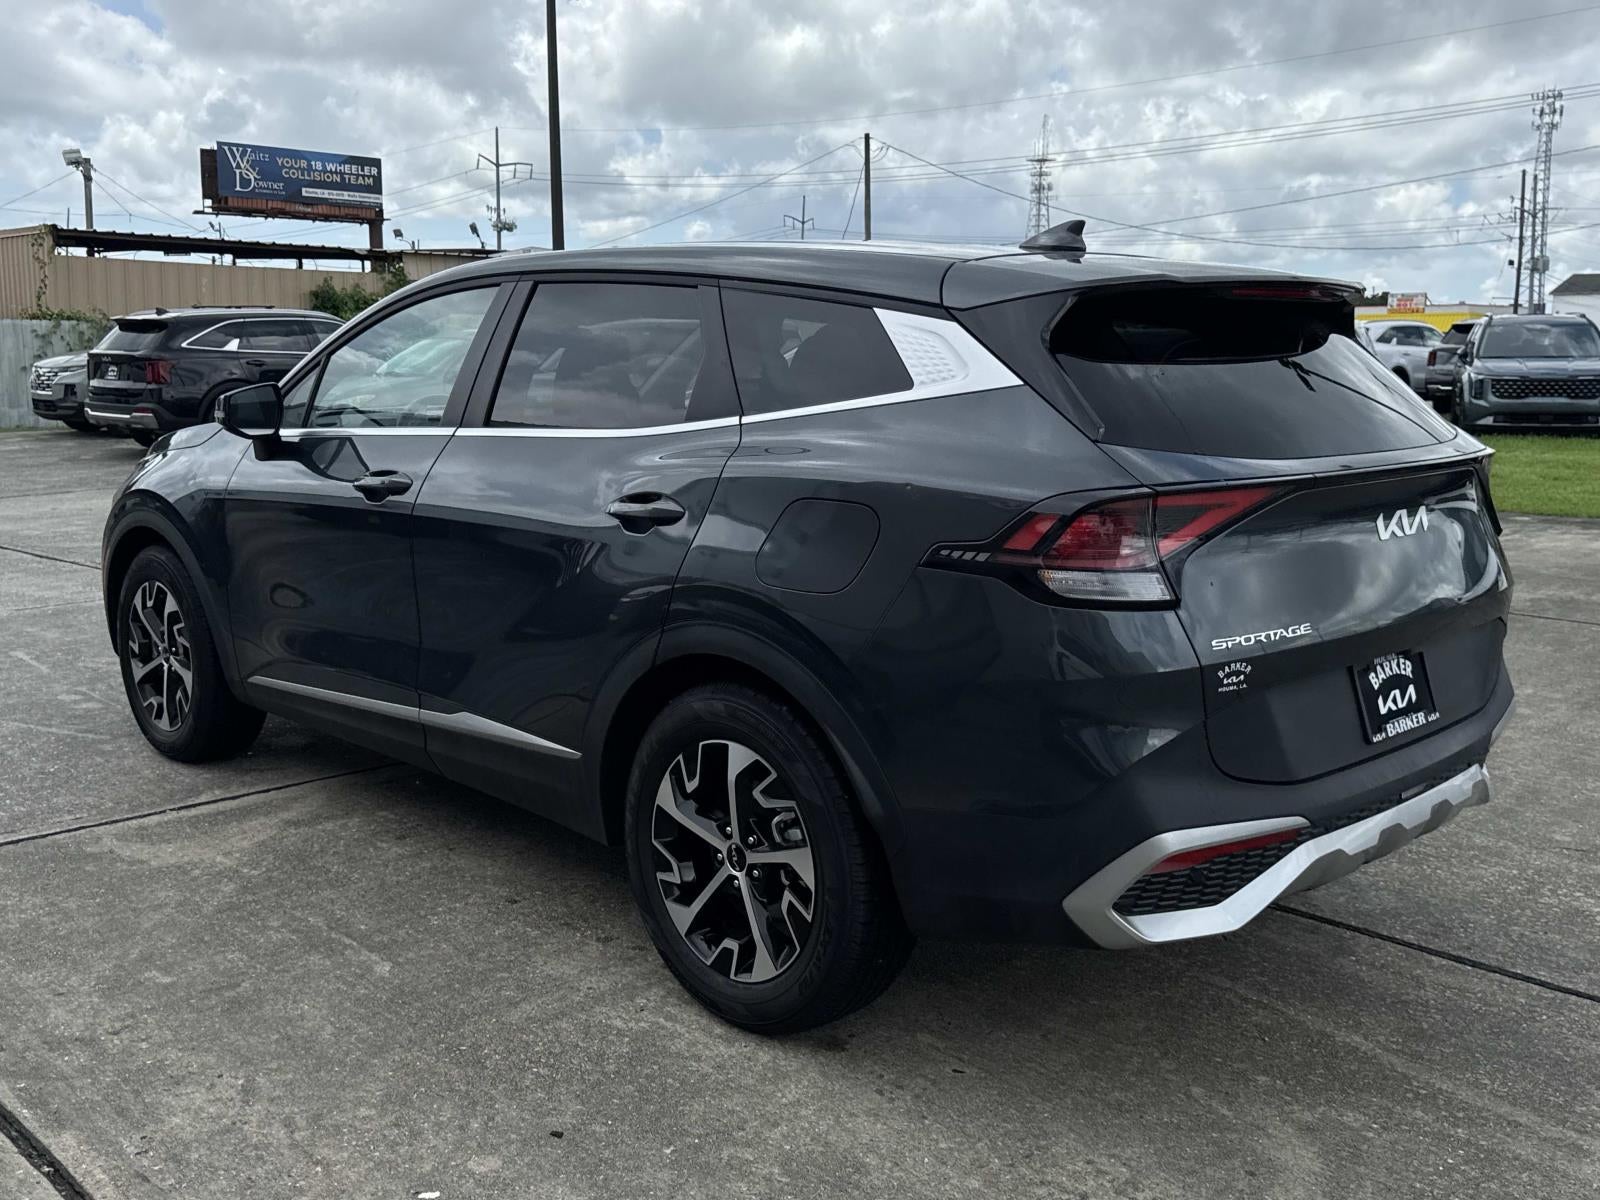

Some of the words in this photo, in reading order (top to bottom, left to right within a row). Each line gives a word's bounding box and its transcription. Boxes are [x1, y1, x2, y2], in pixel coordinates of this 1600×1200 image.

[221, 145, 270, 169] Waitz
[276, 157, 307, 169] YOUR
[311, 161, 322, 171] 18
[326, 162, 378, 177] WHEELER
[233, 168, 285, 192] Downer
[282, 168, 341, 182] COLLISION
[344, 174, 374, 186] TEAM
[1376, 505, 1429, 541] KIA
[1211, 623, 1312, 650] SPORTAGE
[1217, 661, 1252, 679] BARKER
[1223, 674, 1245, 684] KIA
[1368, 656, 1413, 691] BARKER
[1377, 683, 1417, 715] KIA
[1386, 711, 1427, 738] BARKER
